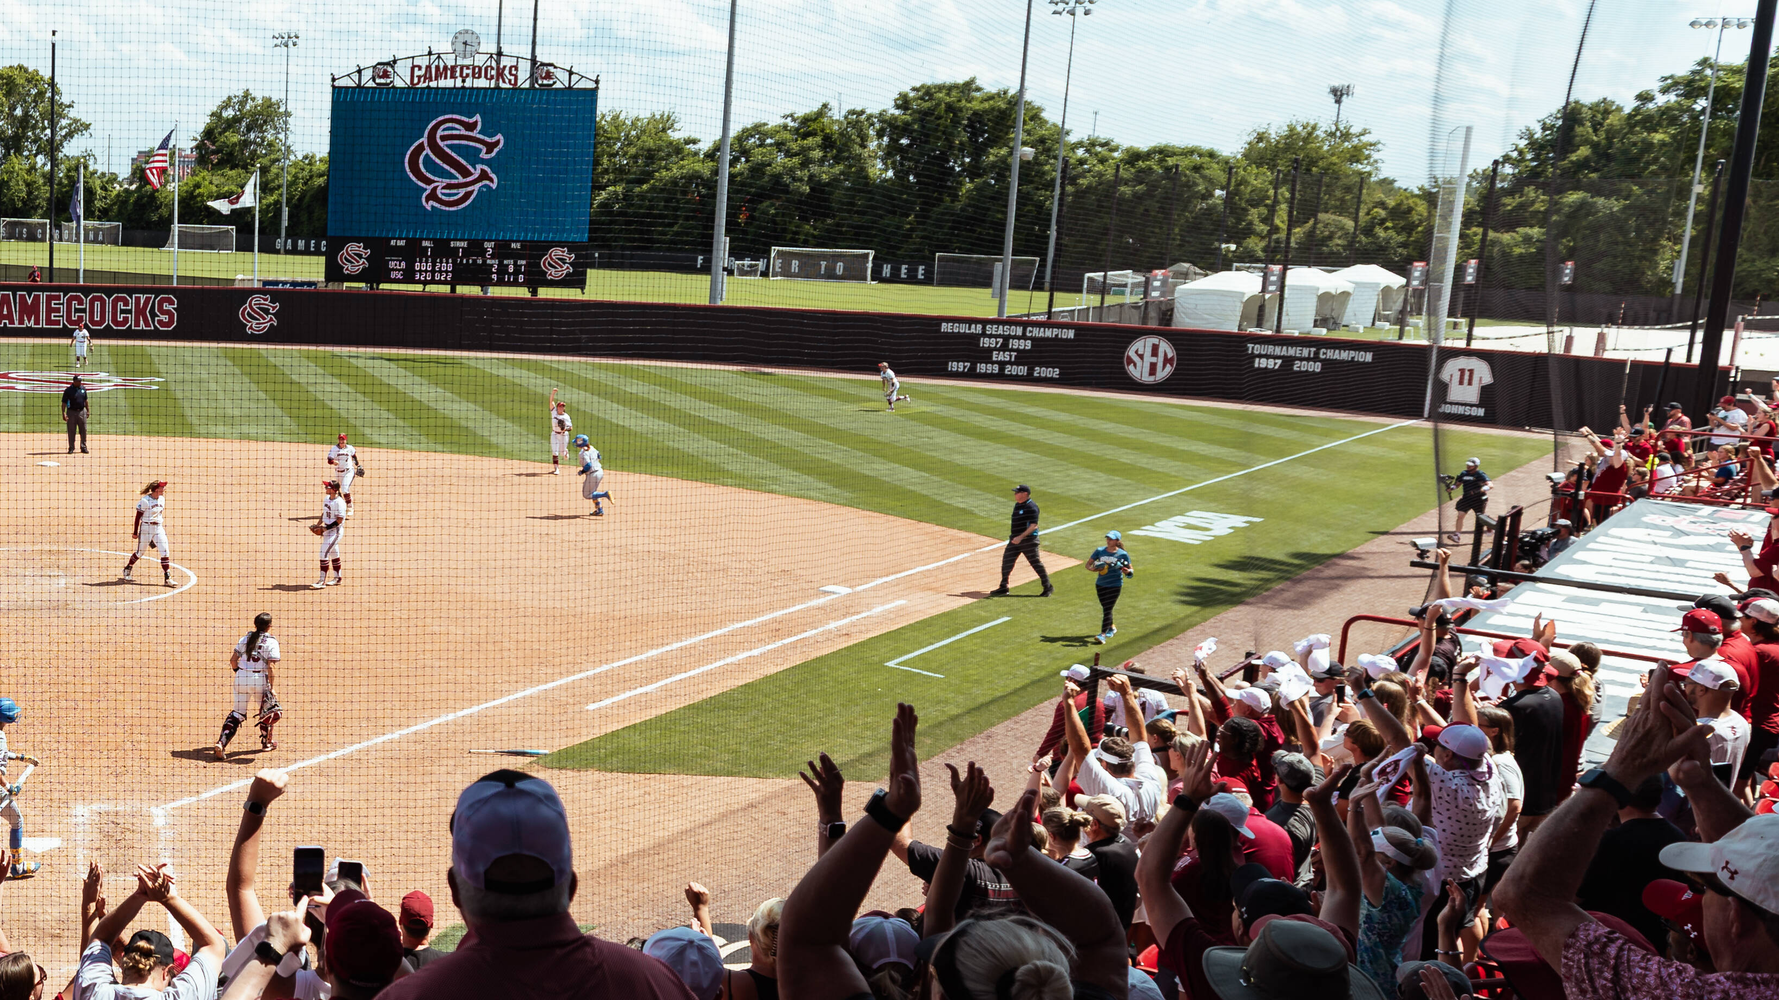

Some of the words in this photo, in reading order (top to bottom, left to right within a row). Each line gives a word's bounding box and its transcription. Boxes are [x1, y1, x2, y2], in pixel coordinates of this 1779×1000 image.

[409, 64, 519, 87] GAMECOCKS
[388, 261, 406, 269] UCLA
[697, 255, 799, 273] FREVER
[820, 261, 844, 275] TO
[866, 262, 925, 279] HEE
[390, 271, 404, 279] USC
[941, 322, 982, 333] REGULAR
[986, 324, 1023, 336] SEASON
[1026, 327, 1075, 339] CHAMPION
[980, 337, 1003, 348] 1997
[1009, 339, 1032, 349] 1999
[992, 351, 1017, 361] EAST
[1128, 337, 1173, 381] SEC
[1247, 343, 1316, 358] TOURNAMENT
[1319, 348, 1373, 362] CHAMPION
[947, 361, 971, 372] 1997
[976, 363, 999, 373] 1999
[1005, 365, 1027, 375] 2001
[1033, 367, 1060, 378] 2002
[1254, 358, 1282, 369] 1997
[1293, 360, 1322, 372] 2000
[1458, 368, 1474, 386] 11
[1438, 404, 1485, 416] JOHNSON
